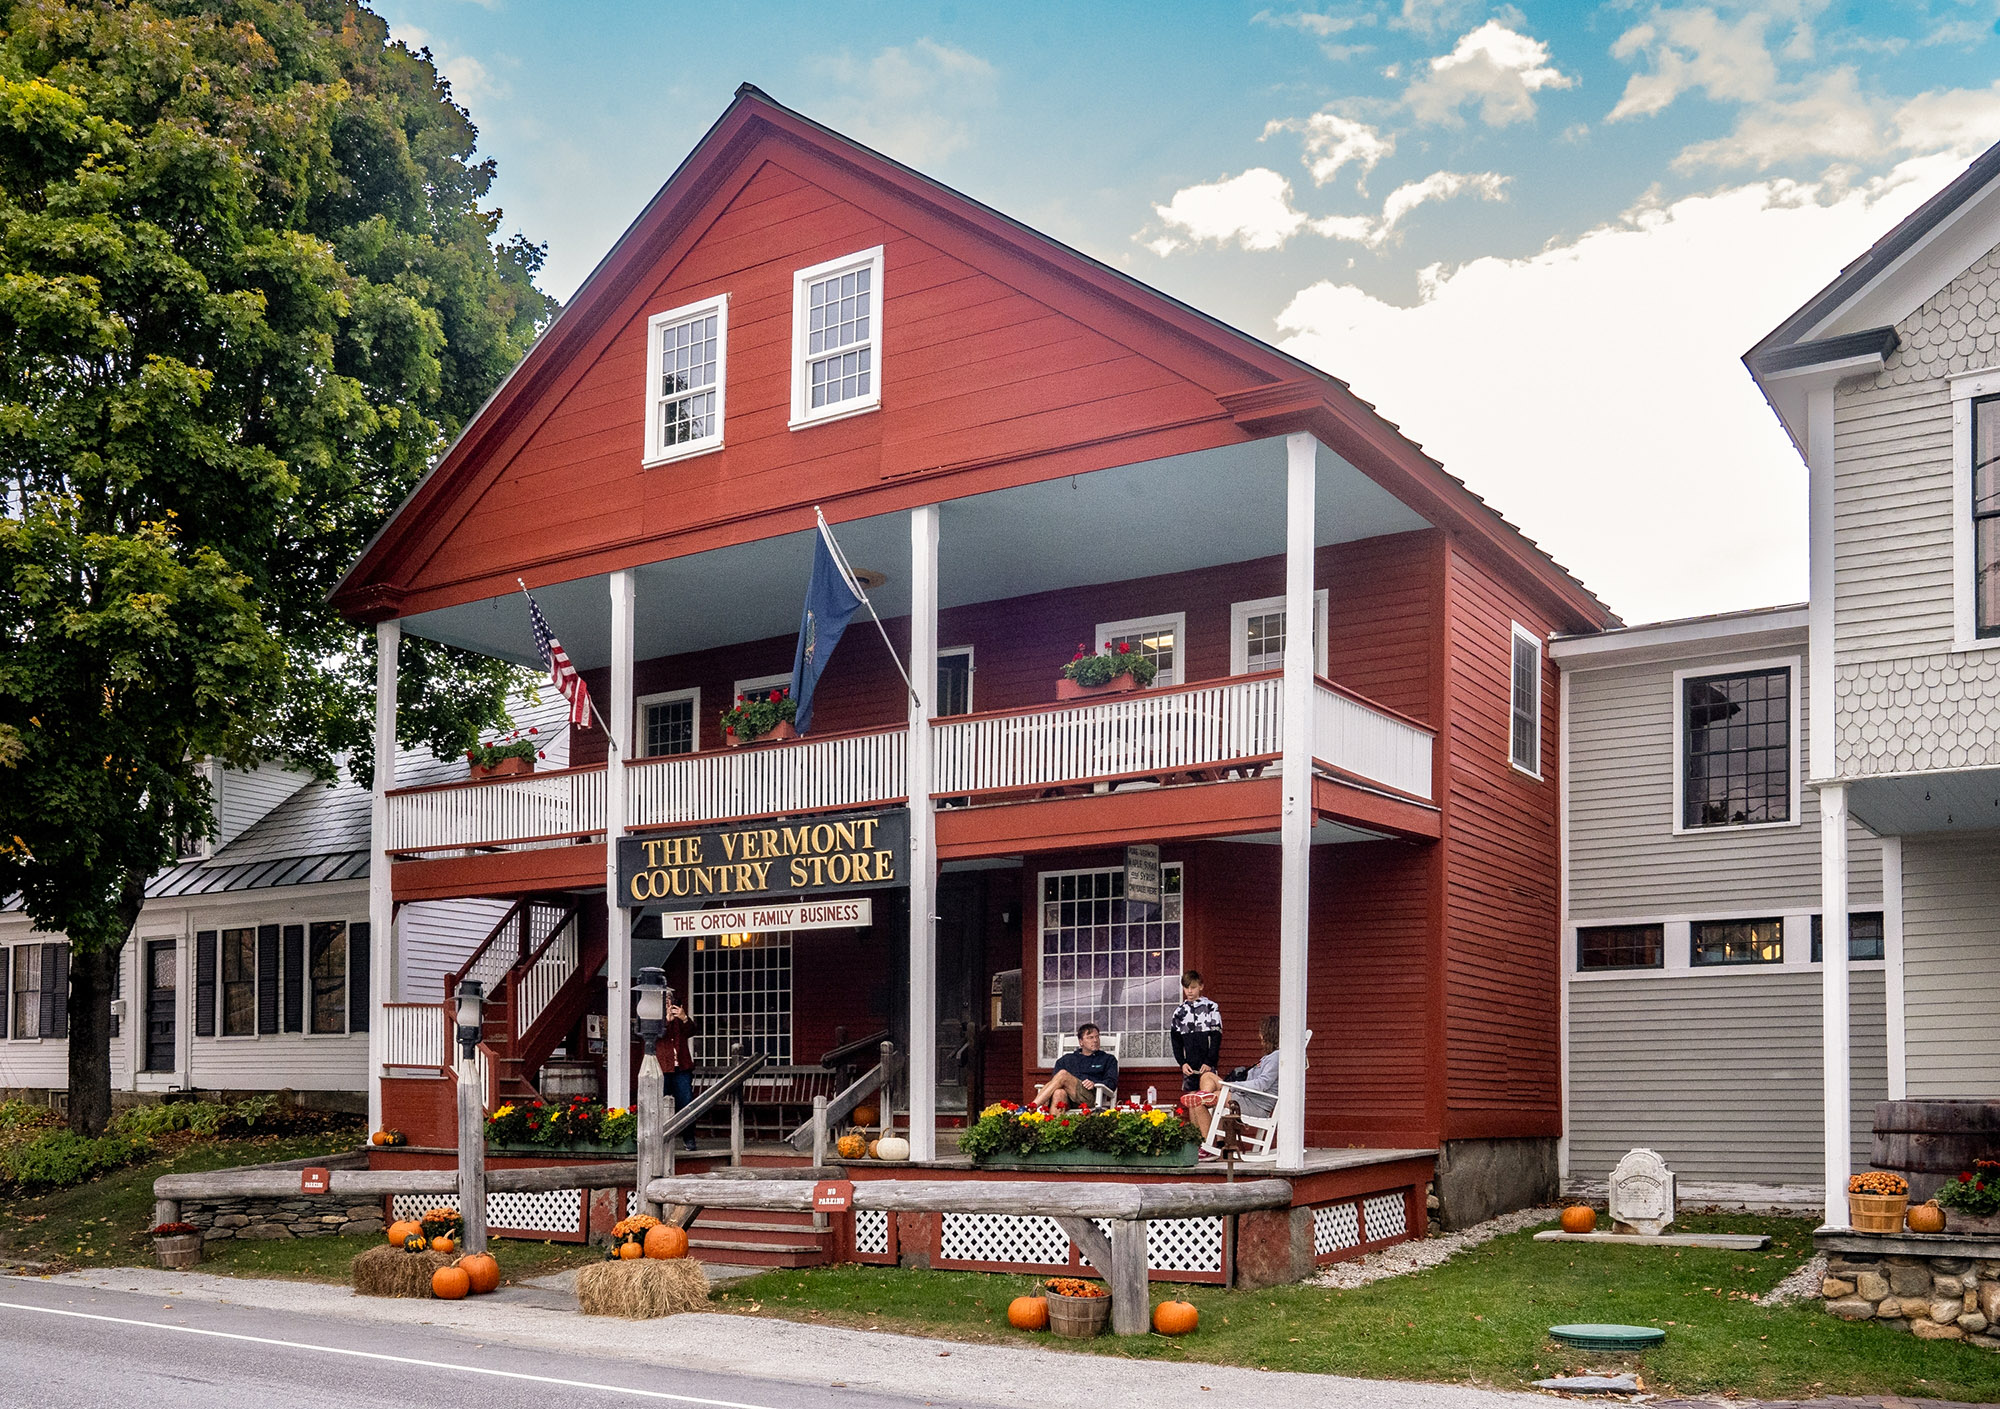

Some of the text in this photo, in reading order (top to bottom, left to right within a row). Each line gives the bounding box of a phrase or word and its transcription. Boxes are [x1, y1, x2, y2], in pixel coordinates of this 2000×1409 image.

[642, 819, 878, 868] THE VERMONT
[631, 850, 894, 900] COUNTRY STORE
[673, 904, 859, 931] THE ORTON FAMILY BUSINESS
[818, 1197, 845, 1205] PARKING
[827, 1188, 837, 1196] NO
